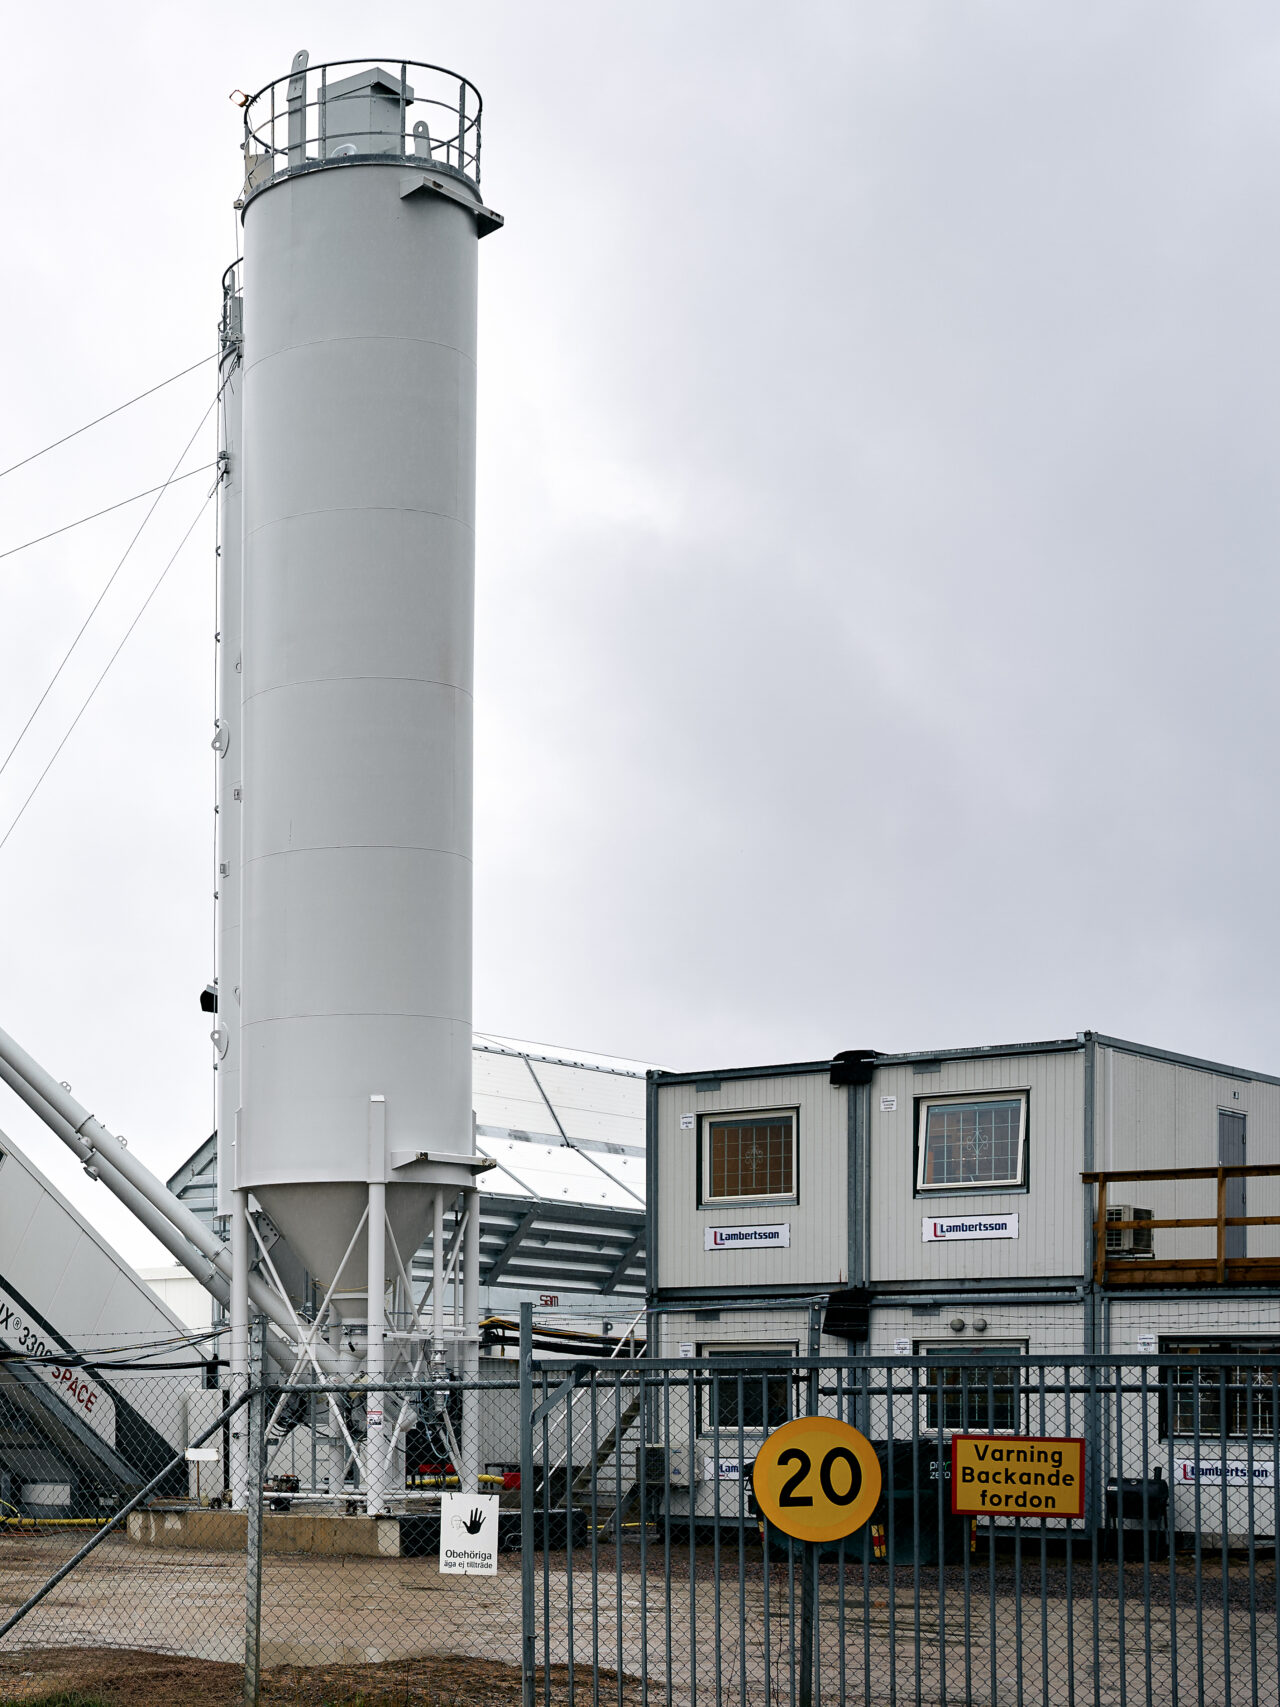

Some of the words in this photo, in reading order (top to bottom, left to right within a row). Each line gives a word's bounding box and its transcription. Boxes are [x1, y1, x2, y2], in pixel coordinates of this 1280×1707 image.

[940, 1222, 1007, 1233] Lambertsson
[719, 1230, 780, 1241] Lambertsson
[974, 1444, 1063, 1469] Varning
[777, 1446, 863, 1508] 20
[961, 1466, 1075, 1487] Backande
[1191, 1465, 1268, 1478] Lambertson
[980, 1489, 1056, 1509] fordon
[445, 1549, 492, 1561] Obehöriga
[443, 1560, 457, 1569] äga
[458, 1561, 465, 1569] ej
